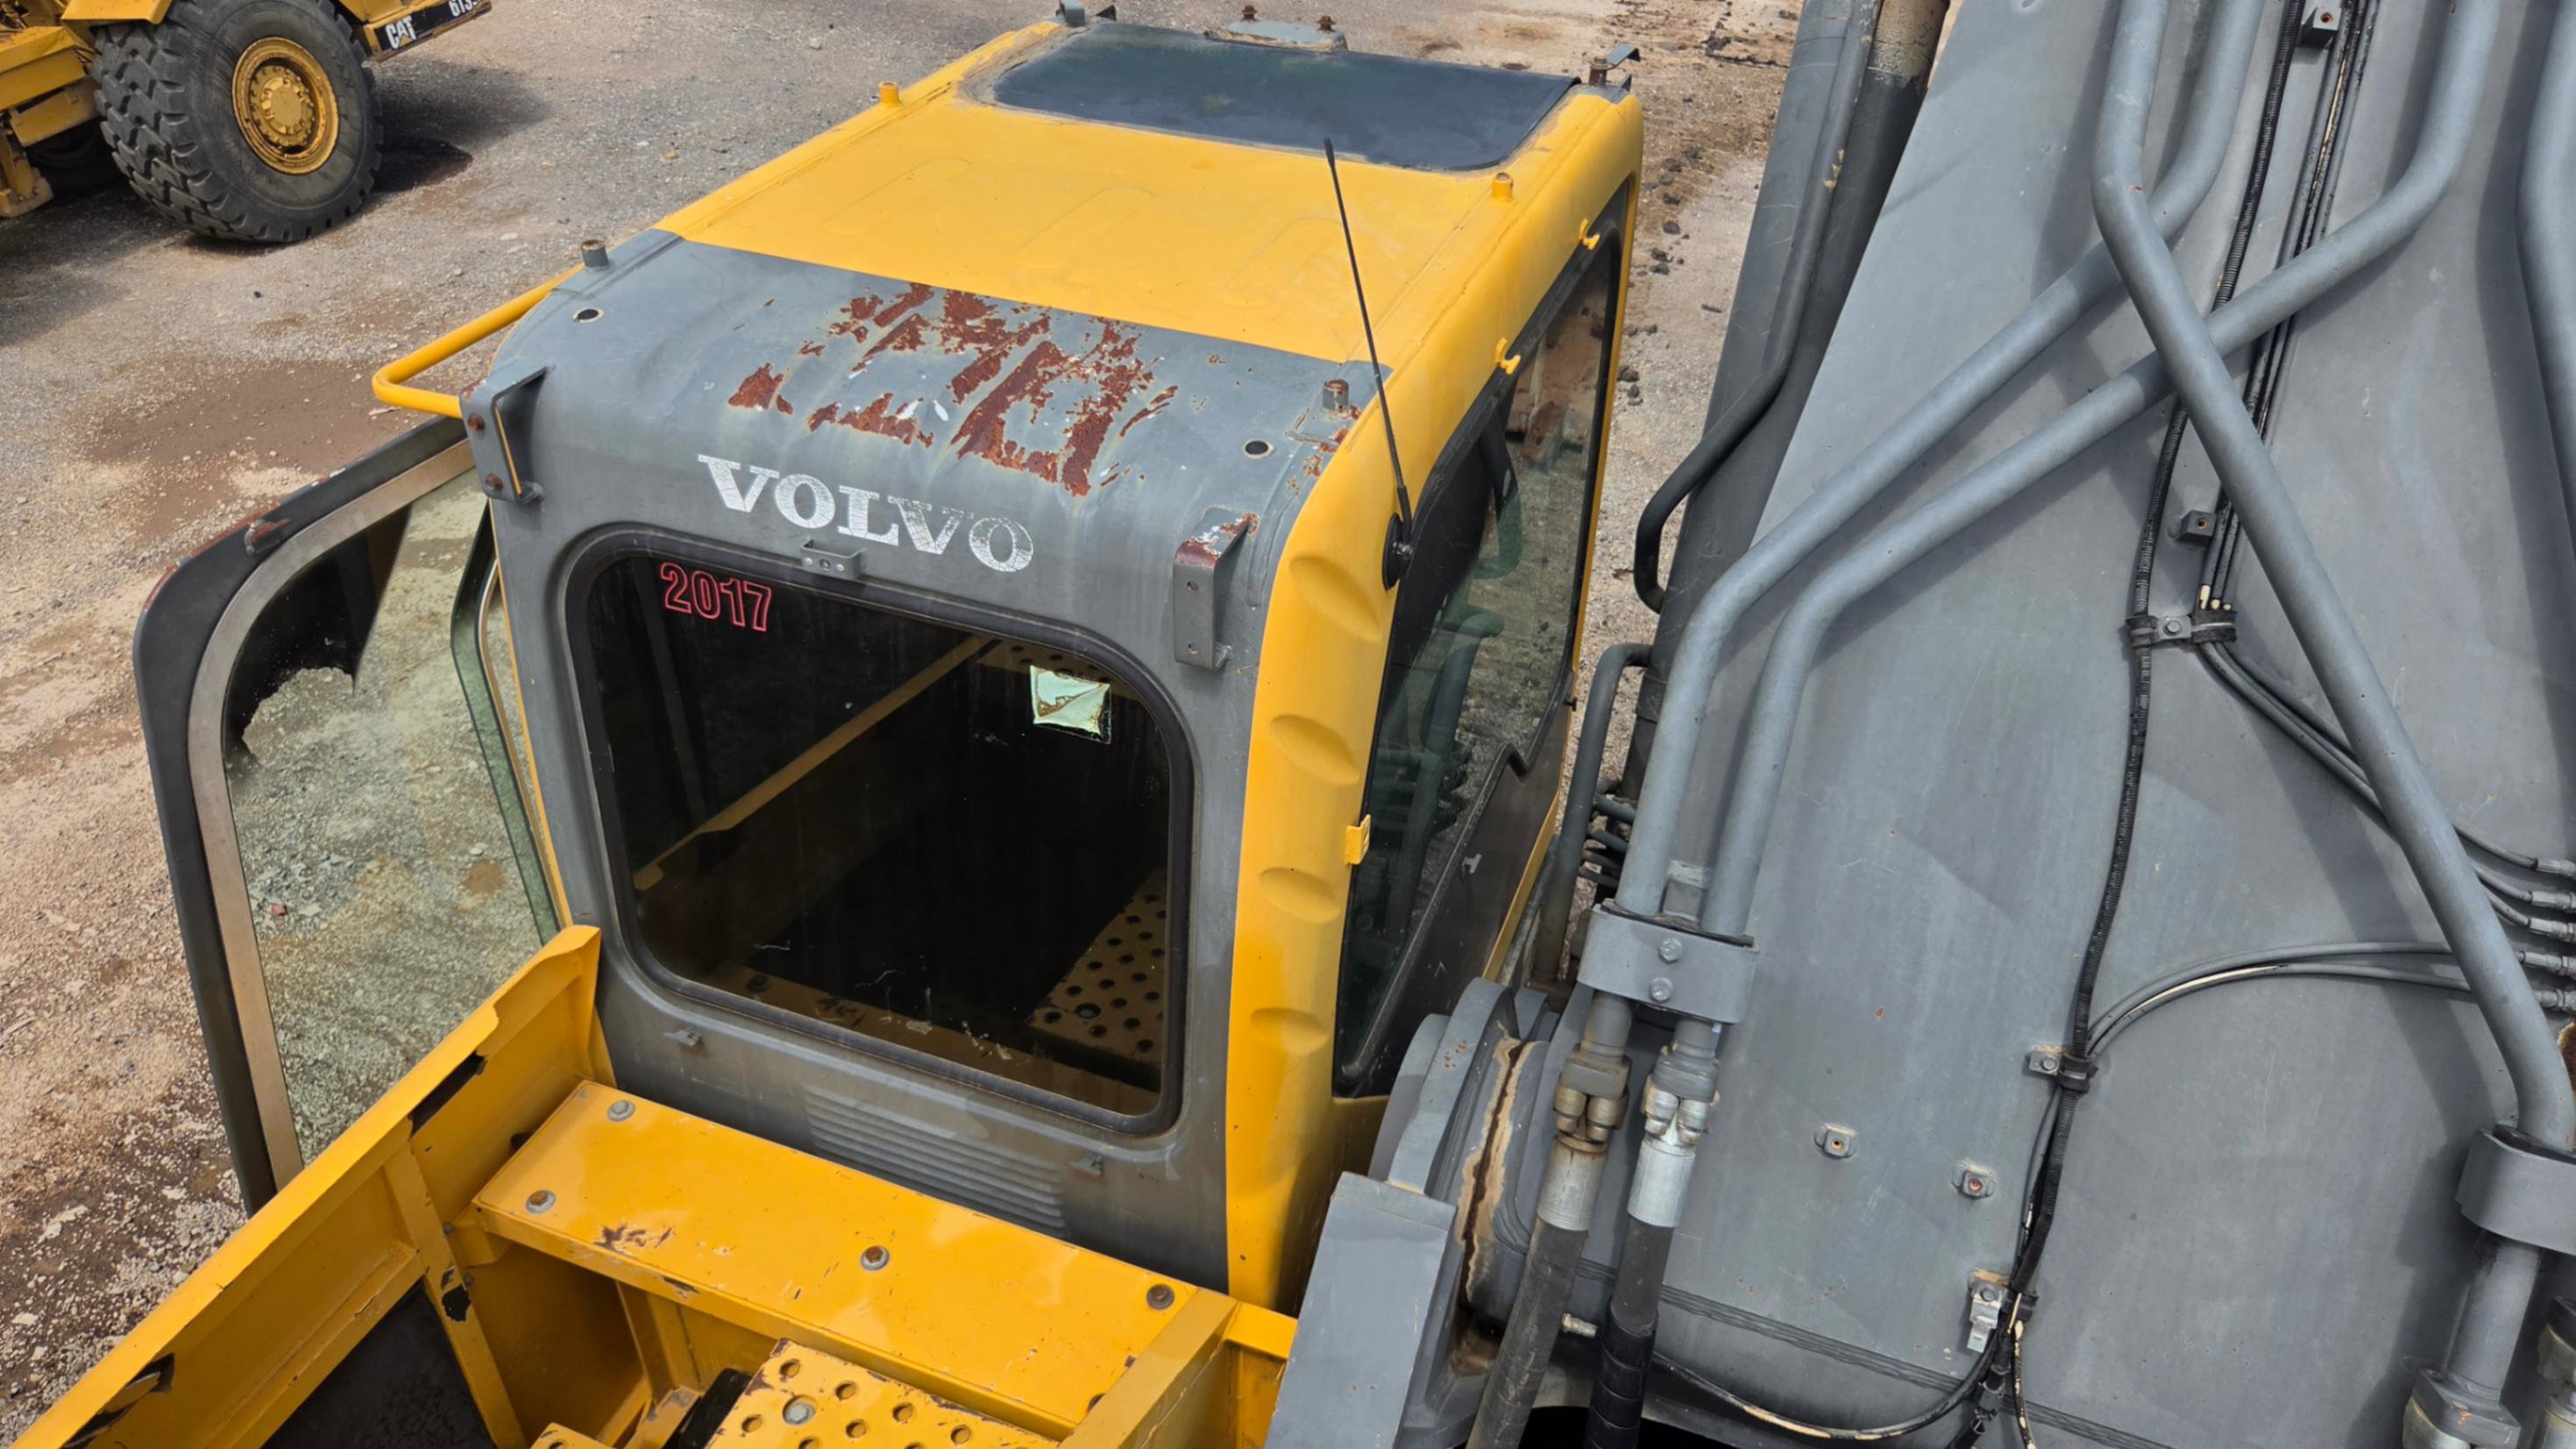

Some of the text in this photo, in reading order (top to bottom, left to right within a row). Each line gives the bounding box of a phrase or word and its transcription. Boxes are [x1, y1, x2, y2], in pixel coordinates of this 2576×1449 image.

[386, 15, 416, 49] CAT
[698, 453, 1034, 572] VOLVO
[660, 562, 772, 632] 2017
